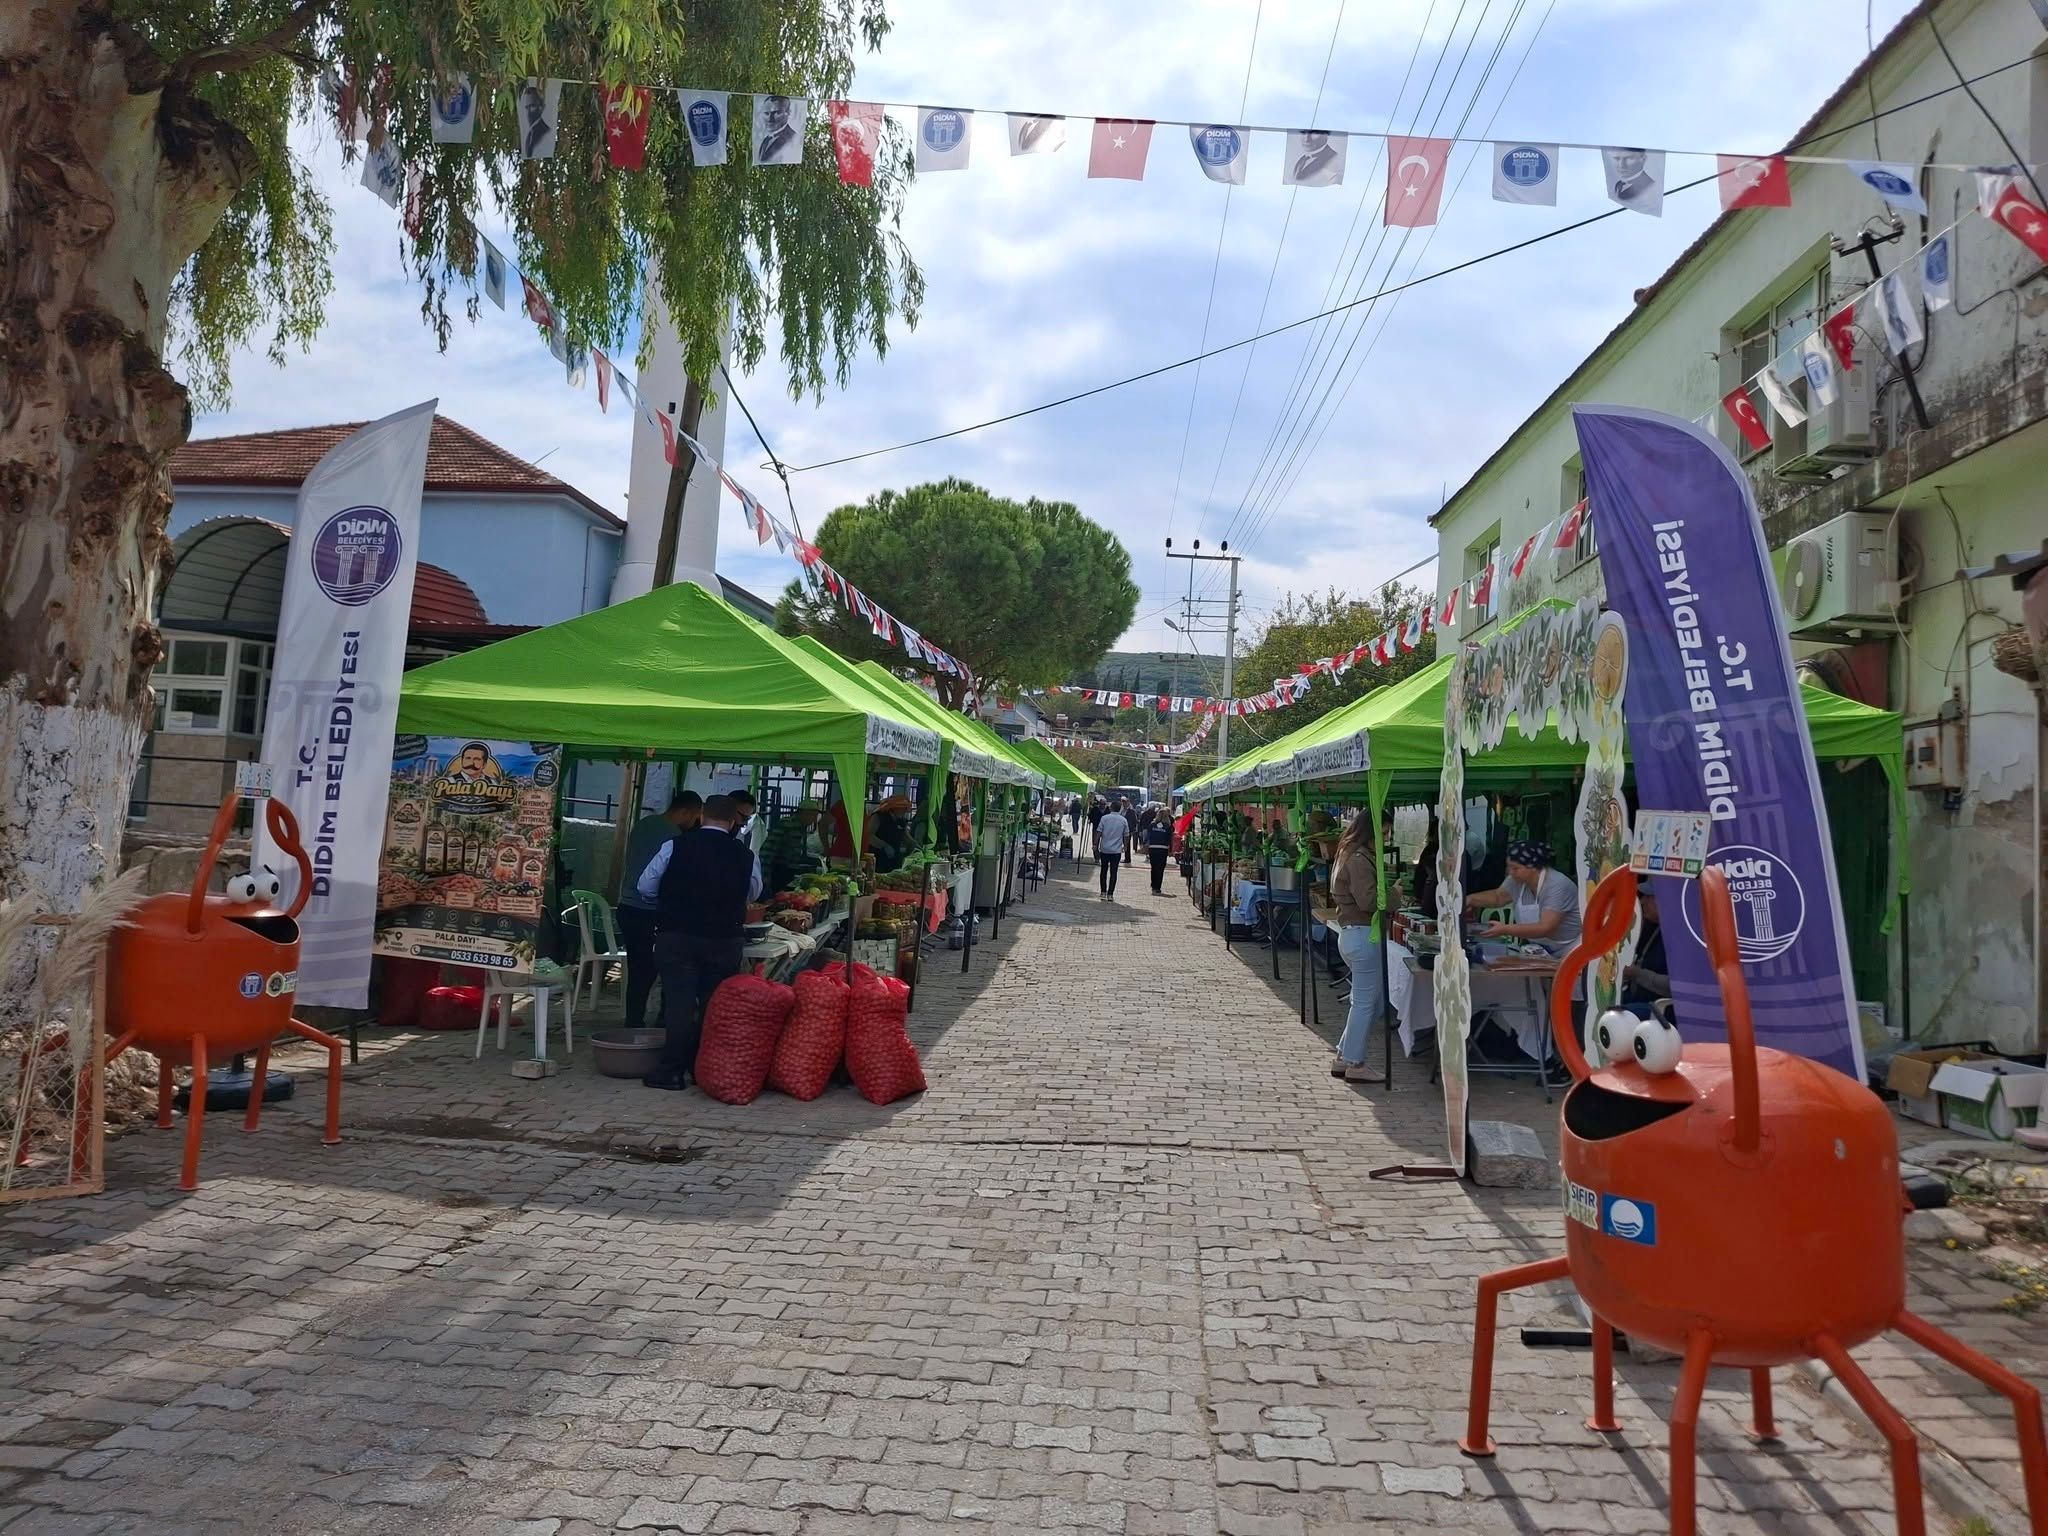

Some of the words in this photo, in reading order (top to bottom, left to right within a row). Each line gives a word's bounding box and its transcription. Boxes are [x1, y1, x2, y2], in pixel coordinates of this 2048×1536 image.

[337, 518, 388, 536] DİDİM
[337, 535, 386, 545] BELEDİYESİ
[1826, 536, 1834, 582] arçelik
[325, 630, 361, 801] BELEDİYESİ
[296, 737, 320, 788] T.C.
[434, 779, 471, 797] Pala
[435, 932, 456, 942] PALA
[451, 950, 471, 961] 0533
[473, 952, 488, 963] 633
[490, 955, 501, 965] 98
[502, 956, 514, 967] 65
[1571, 1184, 1596, 1208] SIFIR
